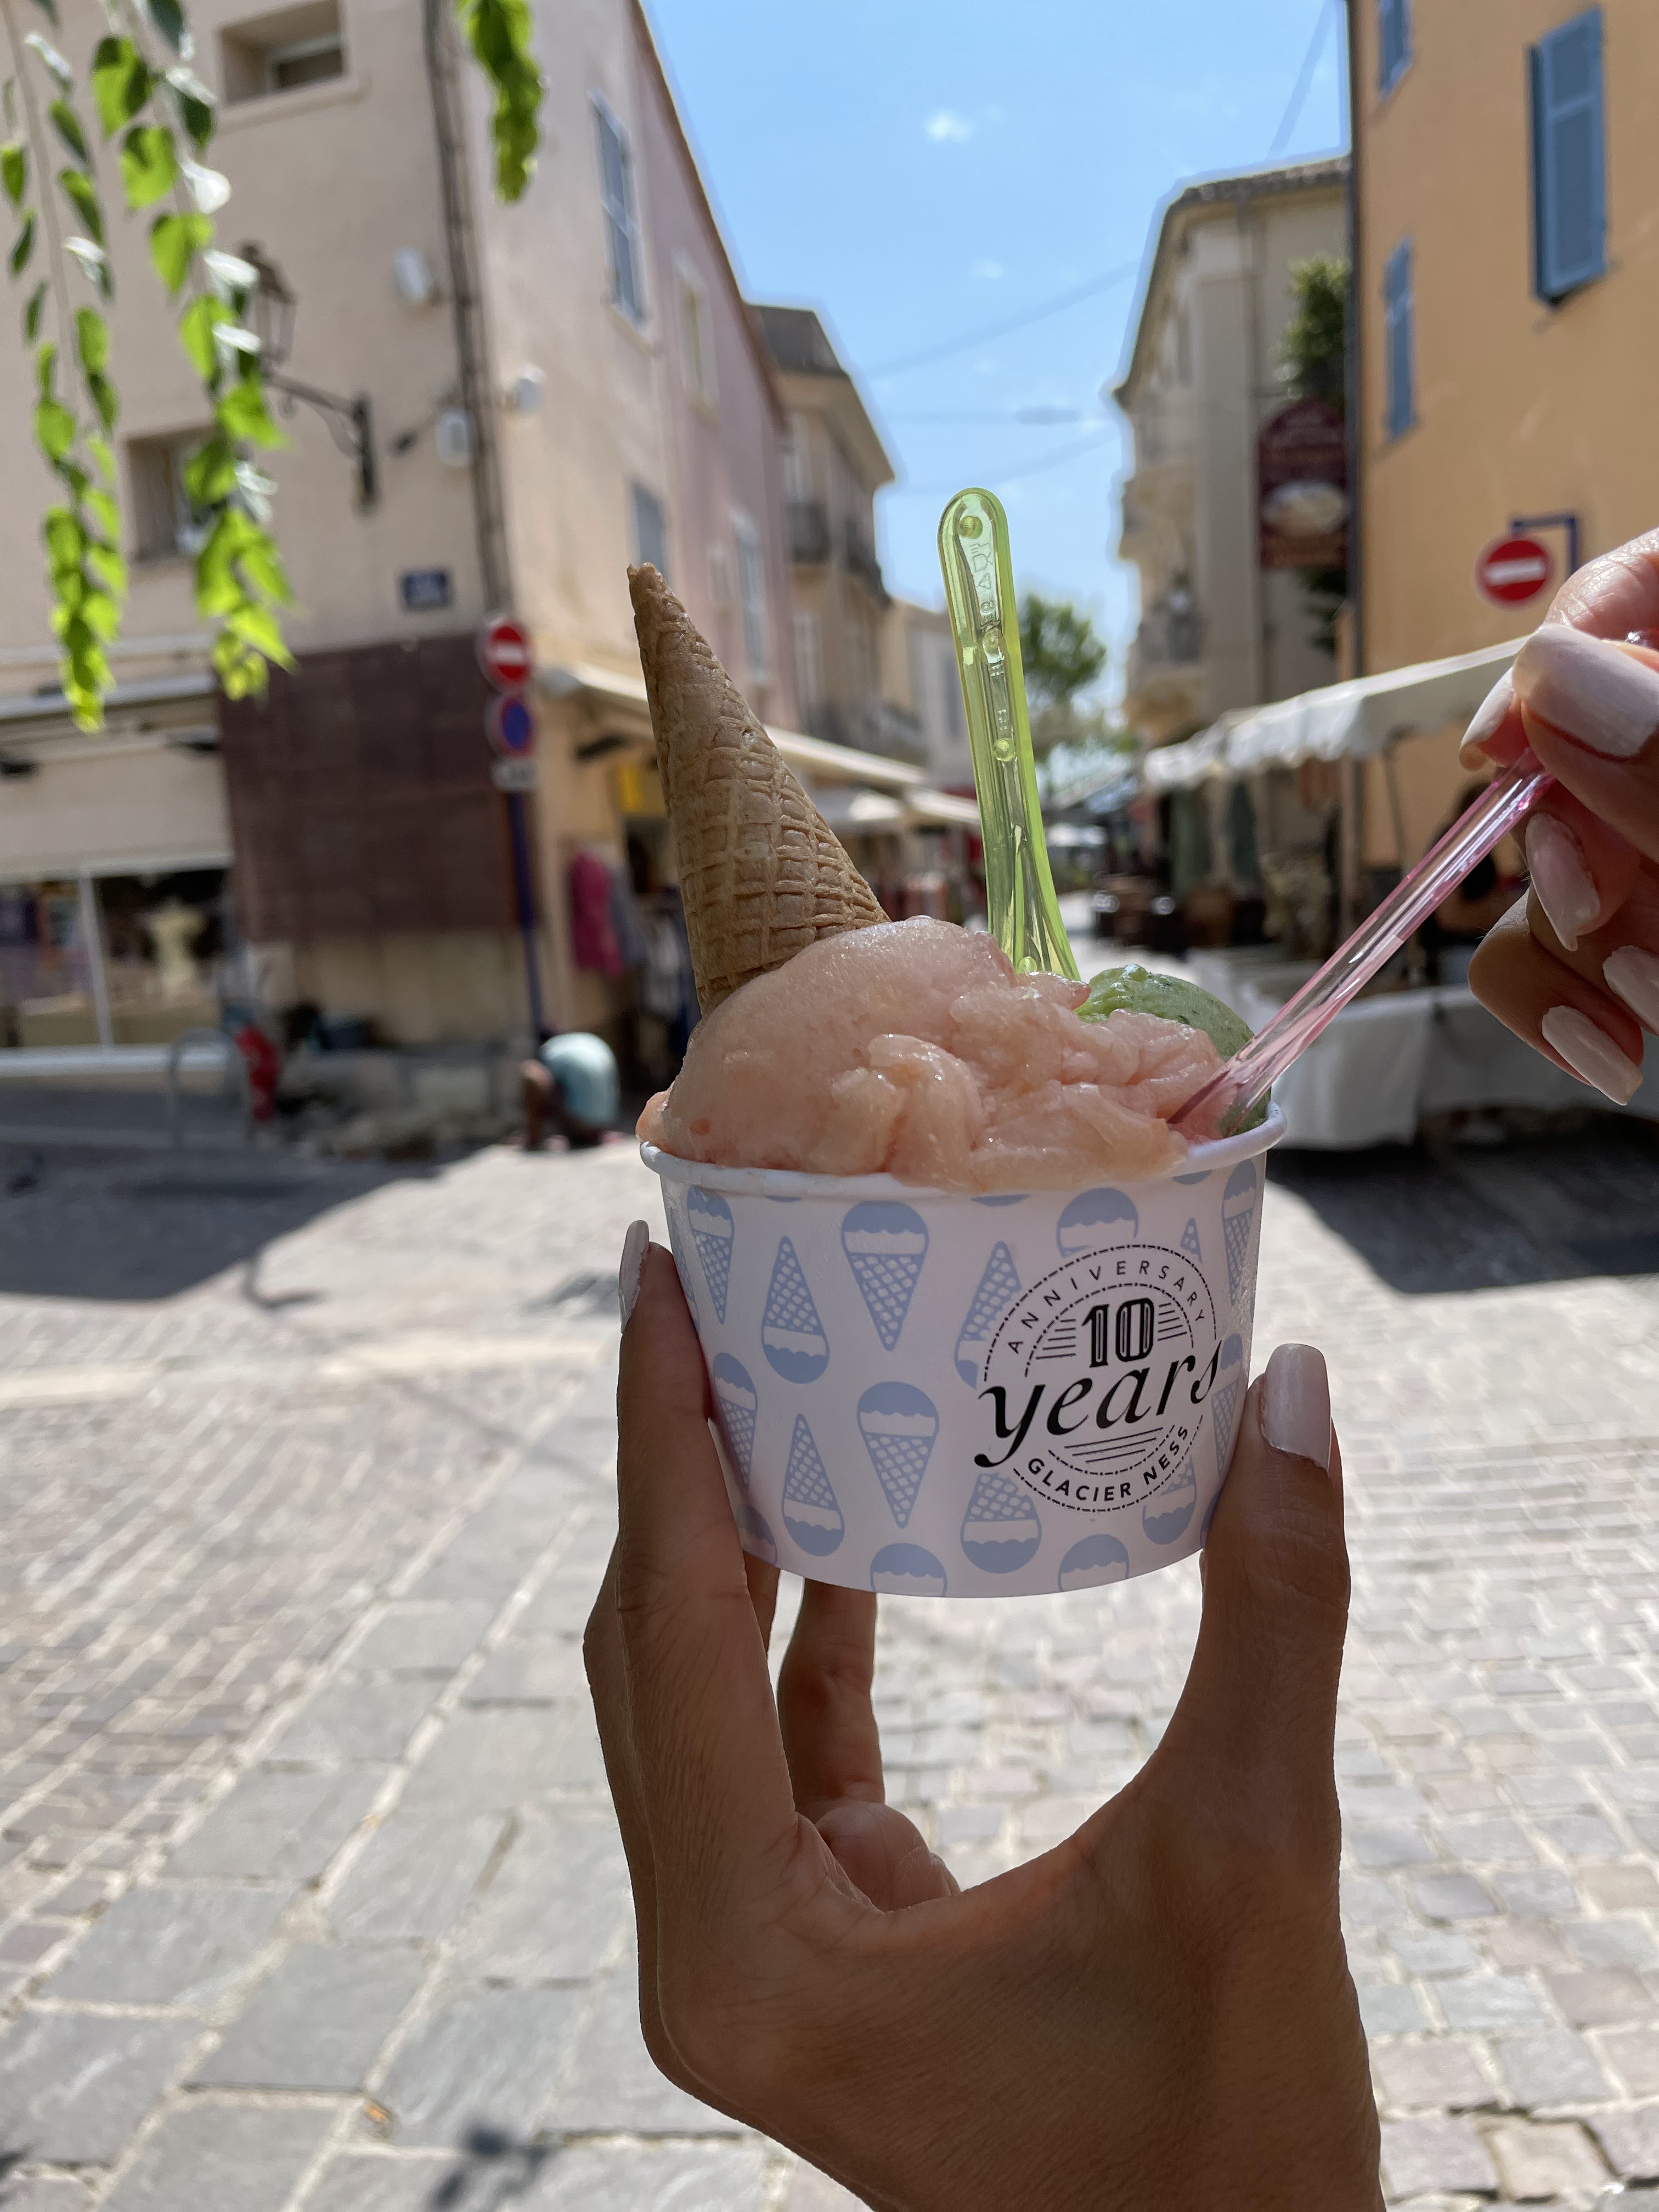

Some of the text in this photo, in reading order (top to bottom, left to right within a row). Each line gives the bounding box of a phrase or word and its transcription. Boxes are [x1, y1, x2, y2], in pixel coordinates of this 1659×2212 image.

[1008, 1260, 1204, 1354] ANNIVERSARY
[1081, 1297, 1155, 1368] 10
[974, 1339, 1222, 1468] years
[1028, 1426, 1188, 1502] GLACIER NESS
